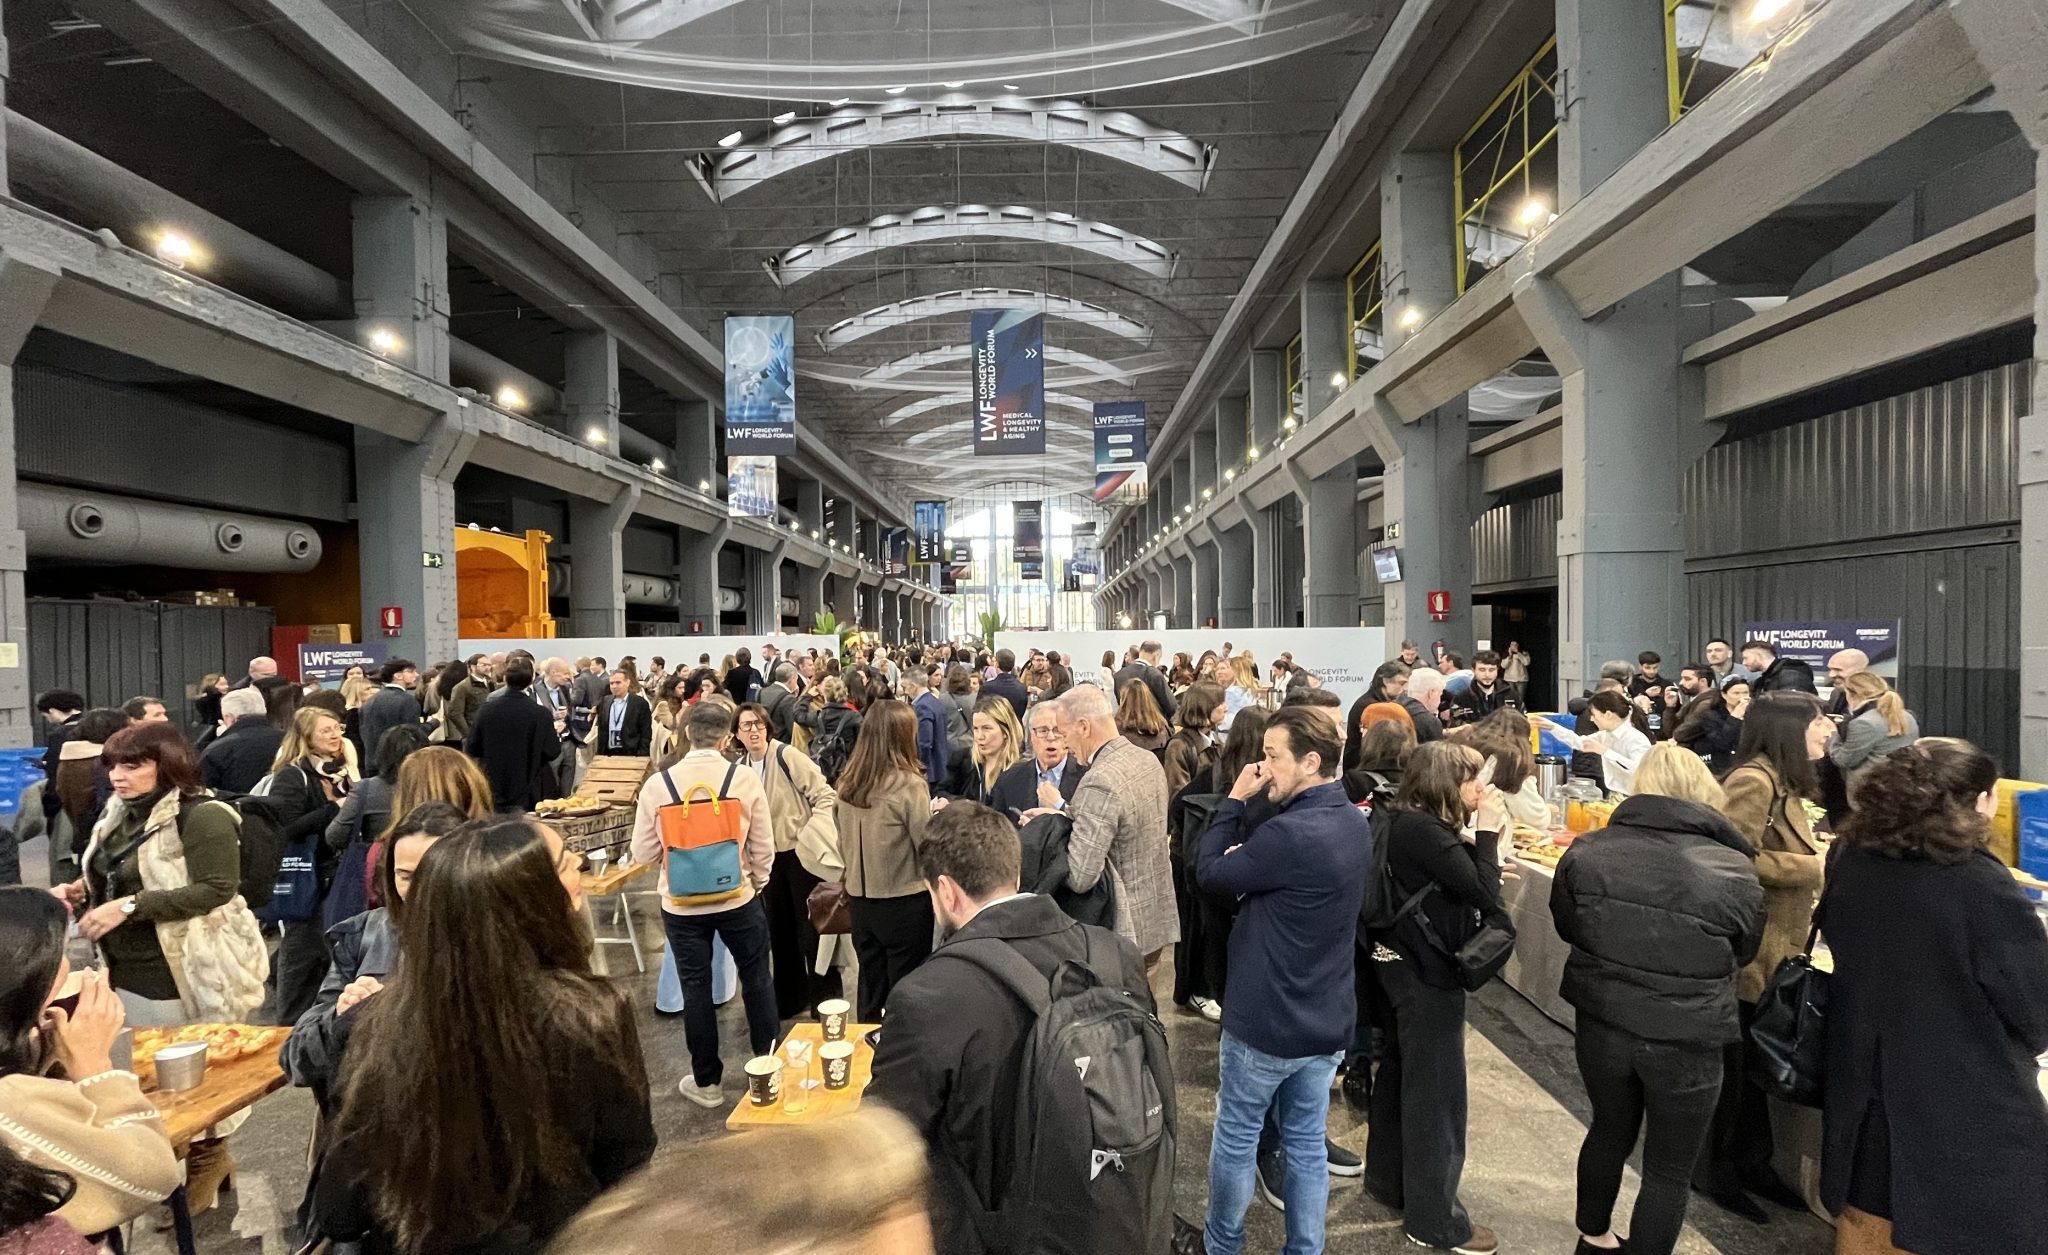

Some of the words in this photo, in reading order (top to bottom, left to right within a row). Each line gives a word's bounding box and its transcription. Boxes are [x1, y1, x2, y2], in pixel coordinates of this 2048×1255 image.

[987, 329, 995, 363] FORUM
[979, 347, 988, 399] LONGEVITY
[988, 366, 996, 399] WORLD
[980, 401, 998, 441] LWF
[1094, 415, 1113, 425] LWF
[727, 427, 752, 439] LWF
[920, 540, 929, 559] LWF
[1780, 629, 1827, 639] LONGEVITY
[1780, 639, 1810, 649] WORLD
[1812, 639, 1845, 649] FORUM
[304, 651, 332, 666] LWF
[1335, 675, 1364, 683] FORUM
